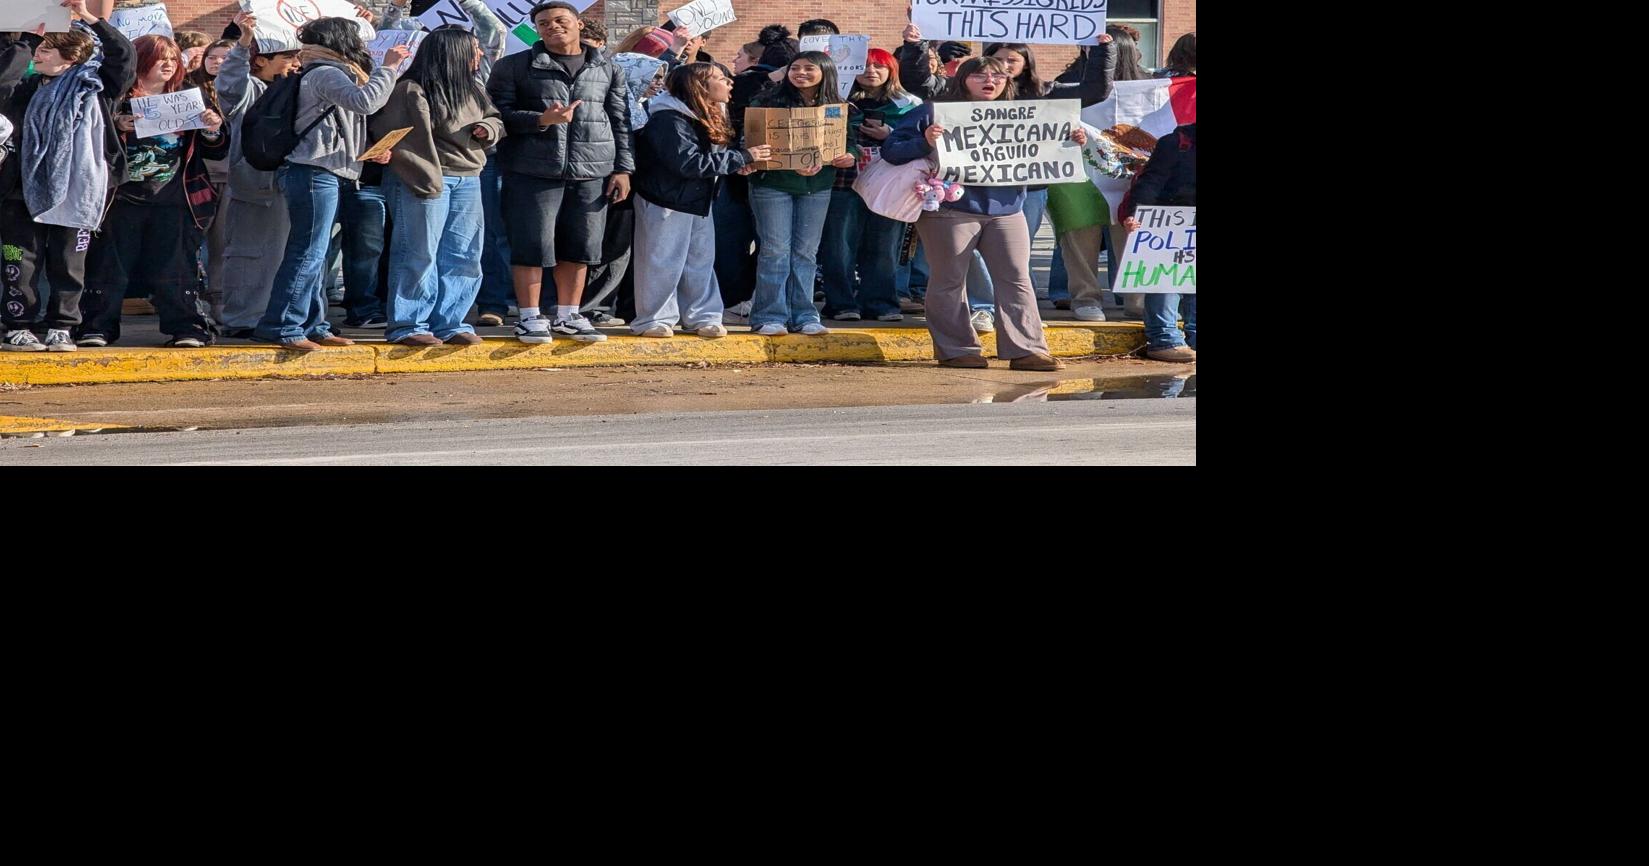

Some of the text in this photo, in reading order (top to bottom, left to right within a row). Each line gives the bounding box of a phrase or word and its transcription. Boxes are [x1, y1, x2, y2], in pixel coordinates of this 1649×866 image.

[938, 9, 1097, 40] THIS HARD
[803, 36, 829, 44] LOVE
[163, 93, 188, 105] WAS
[970, 106, 1037, 122] SANGRE
[158, 118, 185, 131] OLD
[942, 121, 1072, 153] MEXICANA
[943, 160, 1075, 184] MEXICANO
